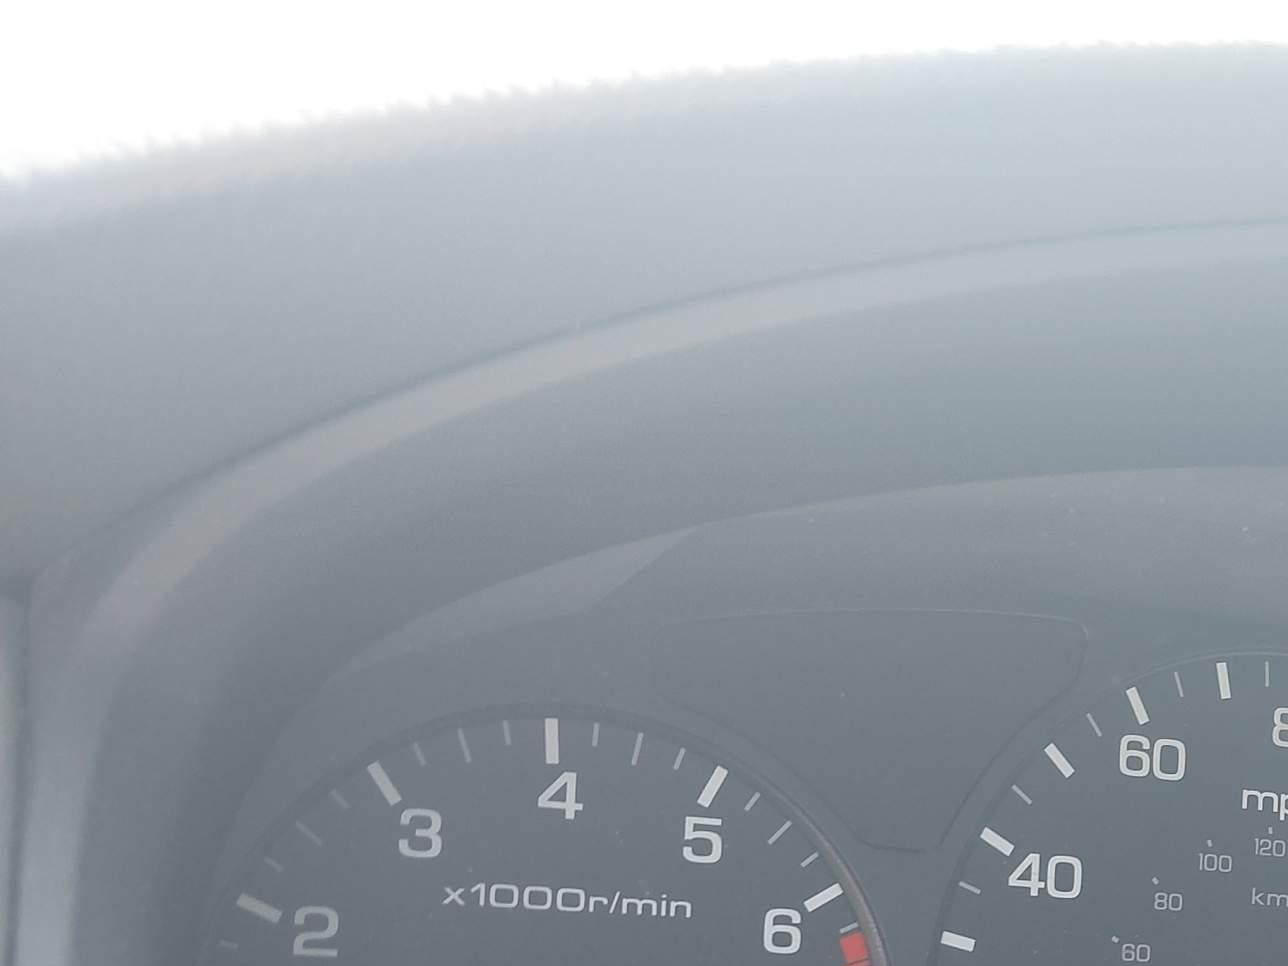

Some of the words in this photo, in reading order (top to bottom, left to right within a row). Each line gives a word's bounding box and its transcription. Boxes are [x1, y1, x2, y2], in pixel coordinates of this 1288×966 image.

[1119, 734, 1186, 781] 60
[537, 771, 584, 820] 4
[398, 808, 442, 858] 3
[682, 815, 722, 864] 5
[1254, 837, 1286, 857] 120
[1007, 852, 1082, 899] 40
[1199, 852, 1233, 873] 100
[1154, 892, 1183, 912] 80
[292, 905, 339, 957] 2
[763, 908, 802, 954] 6
[1121, 943, 1151, 962] 60
